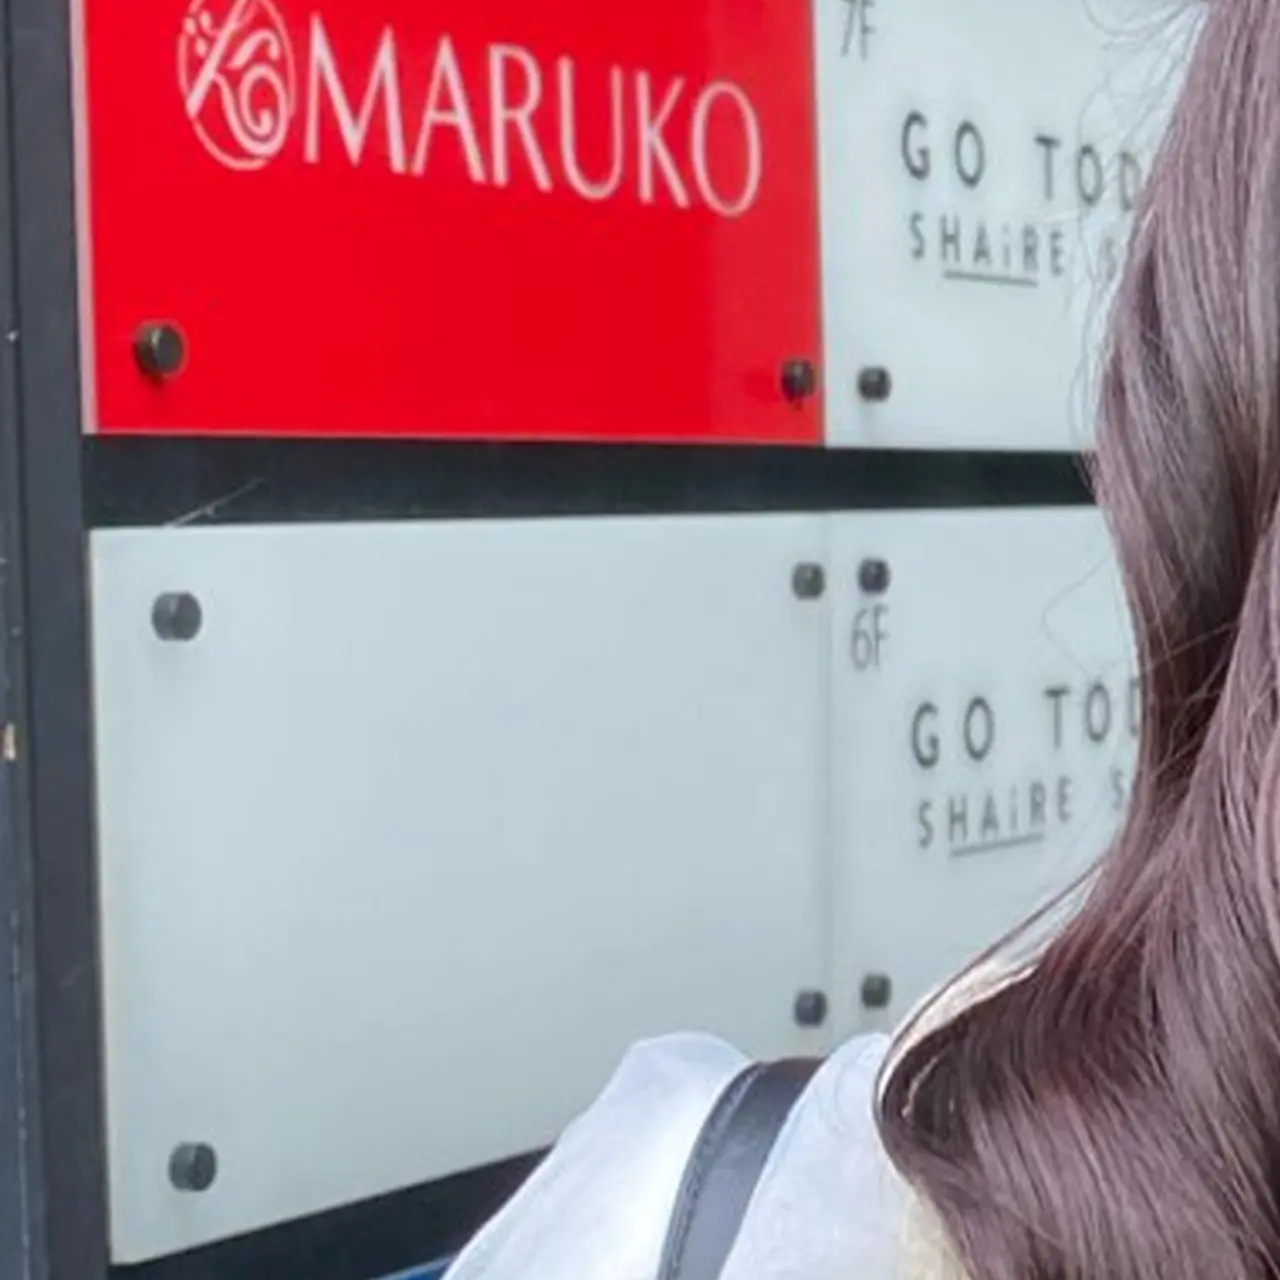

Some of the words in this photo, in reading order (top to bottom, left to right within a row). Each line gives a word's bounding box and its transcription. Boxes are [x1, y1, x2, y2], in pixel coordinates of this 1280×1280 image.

[303, 11, 764, 218] MARUKO
[901, 110, 986, 191] GO
[850, 603, 890, 671] 6F
[909, 695, 996, 771] GO
